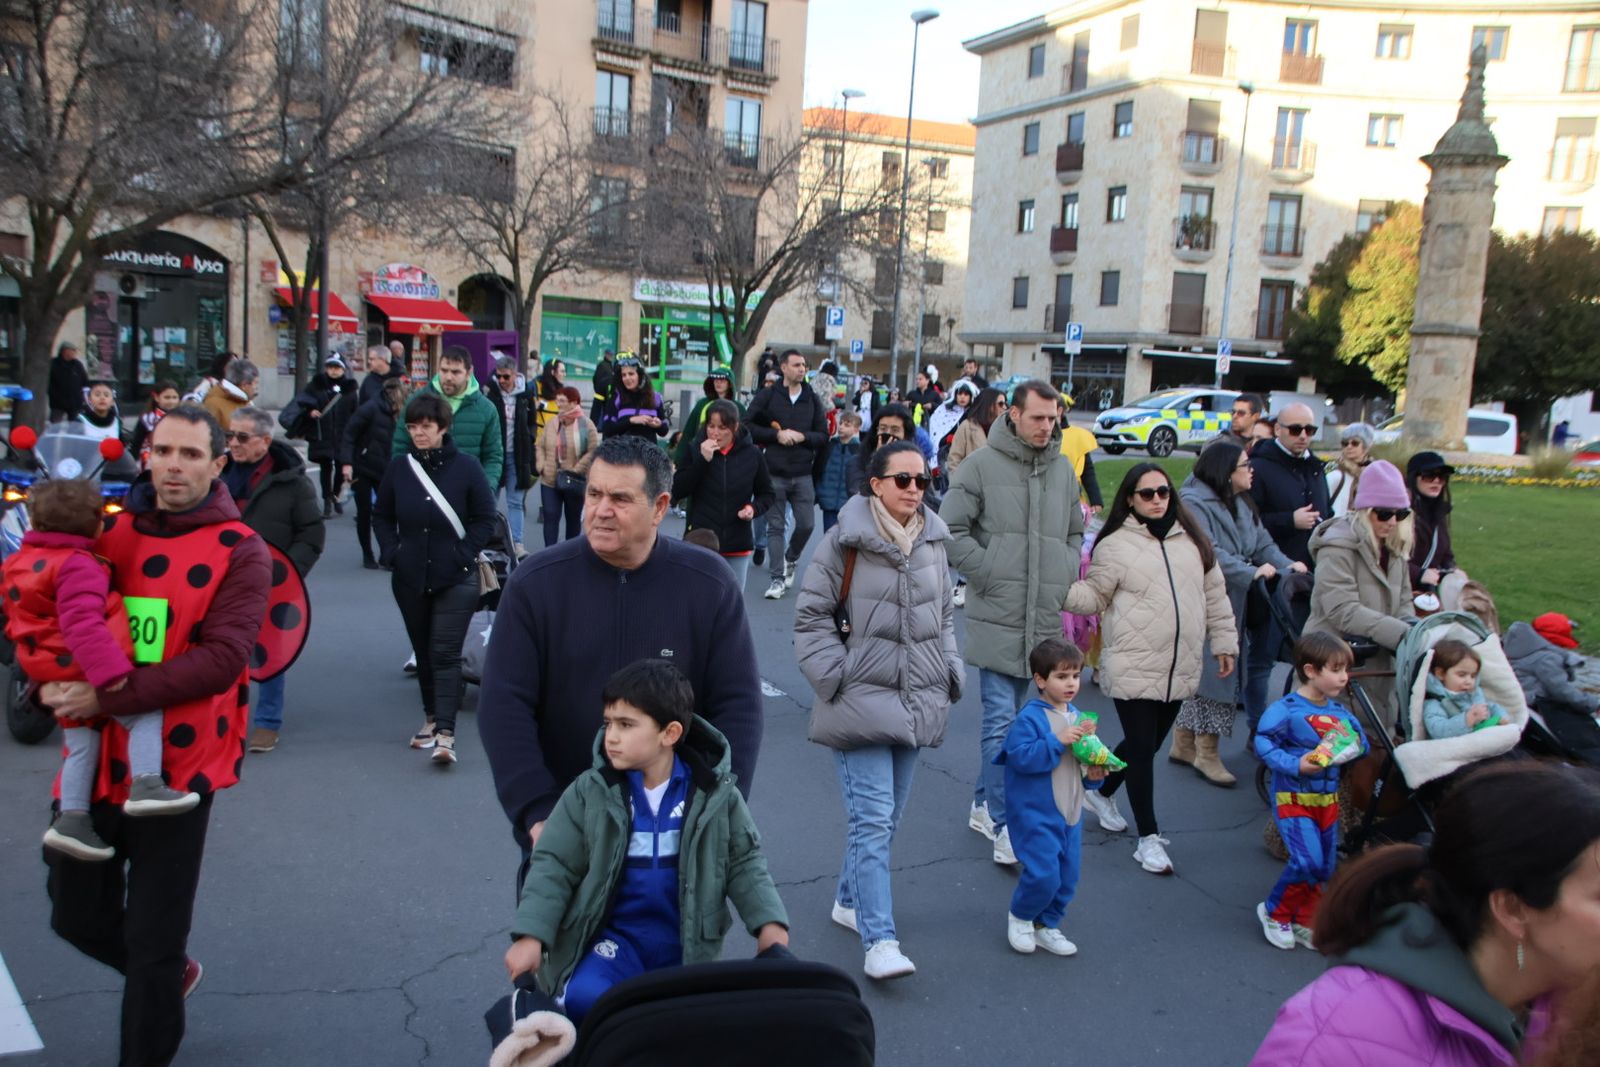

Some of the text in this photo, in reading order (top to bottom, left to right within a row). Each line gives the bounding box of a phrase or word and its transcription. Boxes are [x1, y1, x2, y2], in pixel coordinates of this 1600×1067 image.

[182, 254, 225, 274] Alysa
[830, 308, 841, 325] P
[1070, 323, 1080, 340] P
[853, 340, 862, 353] P
[129, 615, 158, 645] 30
